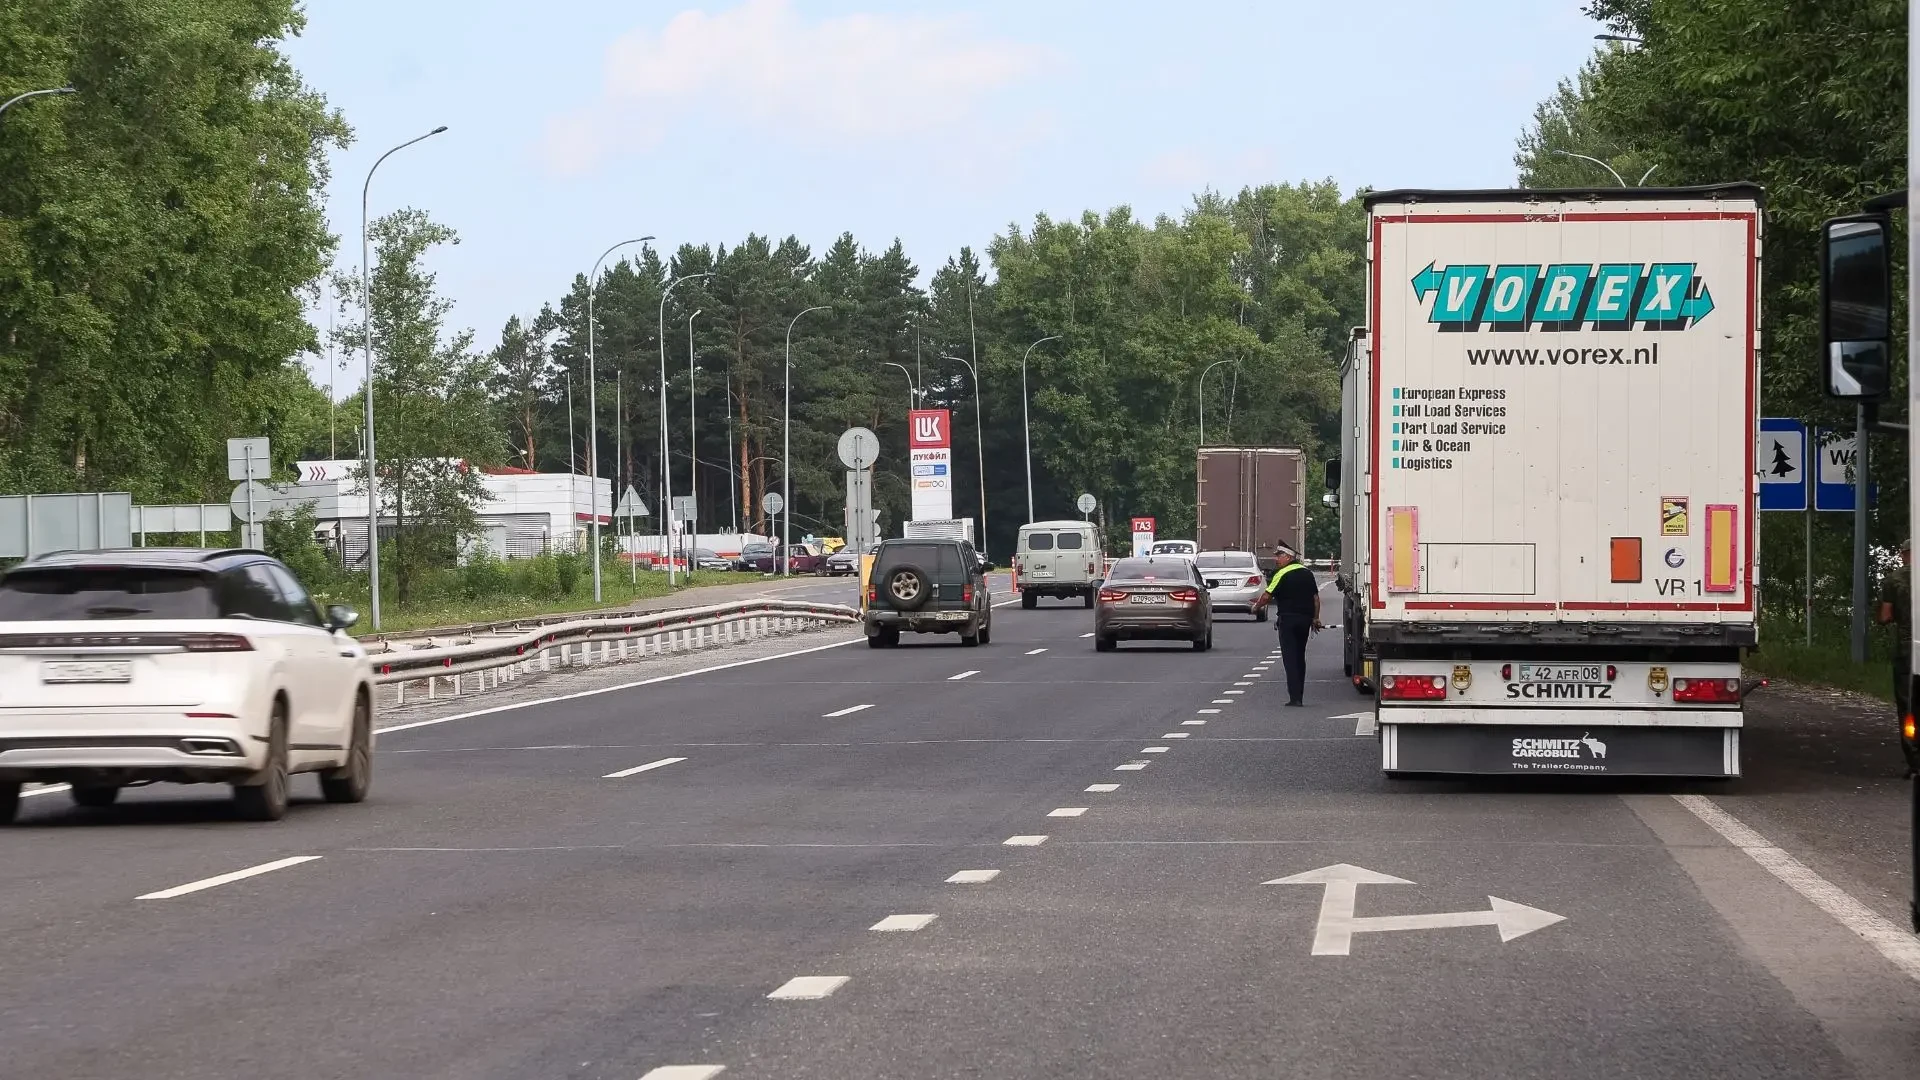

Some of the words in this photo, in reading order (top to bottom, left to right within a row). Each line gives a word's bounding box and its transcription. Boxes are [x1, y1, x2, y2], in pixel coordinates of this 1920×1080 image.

[1443, 272, 1684, 314] VOREX
[1467, 343, 1659, 365] www.vorex.nl
[1401, 387, 1456, 401] European
[1459, 387, 1506, 401] Express
[1401, 404, 1421, 417] Full
[1424, 404, 1451, 417] Load
[1454, 404, 1506, 417] Services
[1401, 422, 1427, 434] Part
[1430, 422, 1458, 434] Load
[1460, 422, 1506, 434] Service
[1401, 439, 1419, 452] Air
[1422, 439, 1433, 452] &
[1436, 439, 1471, 452] Ocean
[913, 451, 947, 461] ЛУКОЙЛ
[1401, 457, 1453, 471] Logistics
[1135, 521, 1152, 531] ГАЗ
[1654, 578, 1686, 596] VR
[1535, 667, 1551, 680] 42
[1556, 669, 1579, 680] AFR
[1583, 667, 1599, 680] 08
[1506, 683, 1612, 699] SCHMITZ
[1512, 738, 1580, 750] SCHMITZ
[1512, 749, 1580, 758] CARGOBULL
